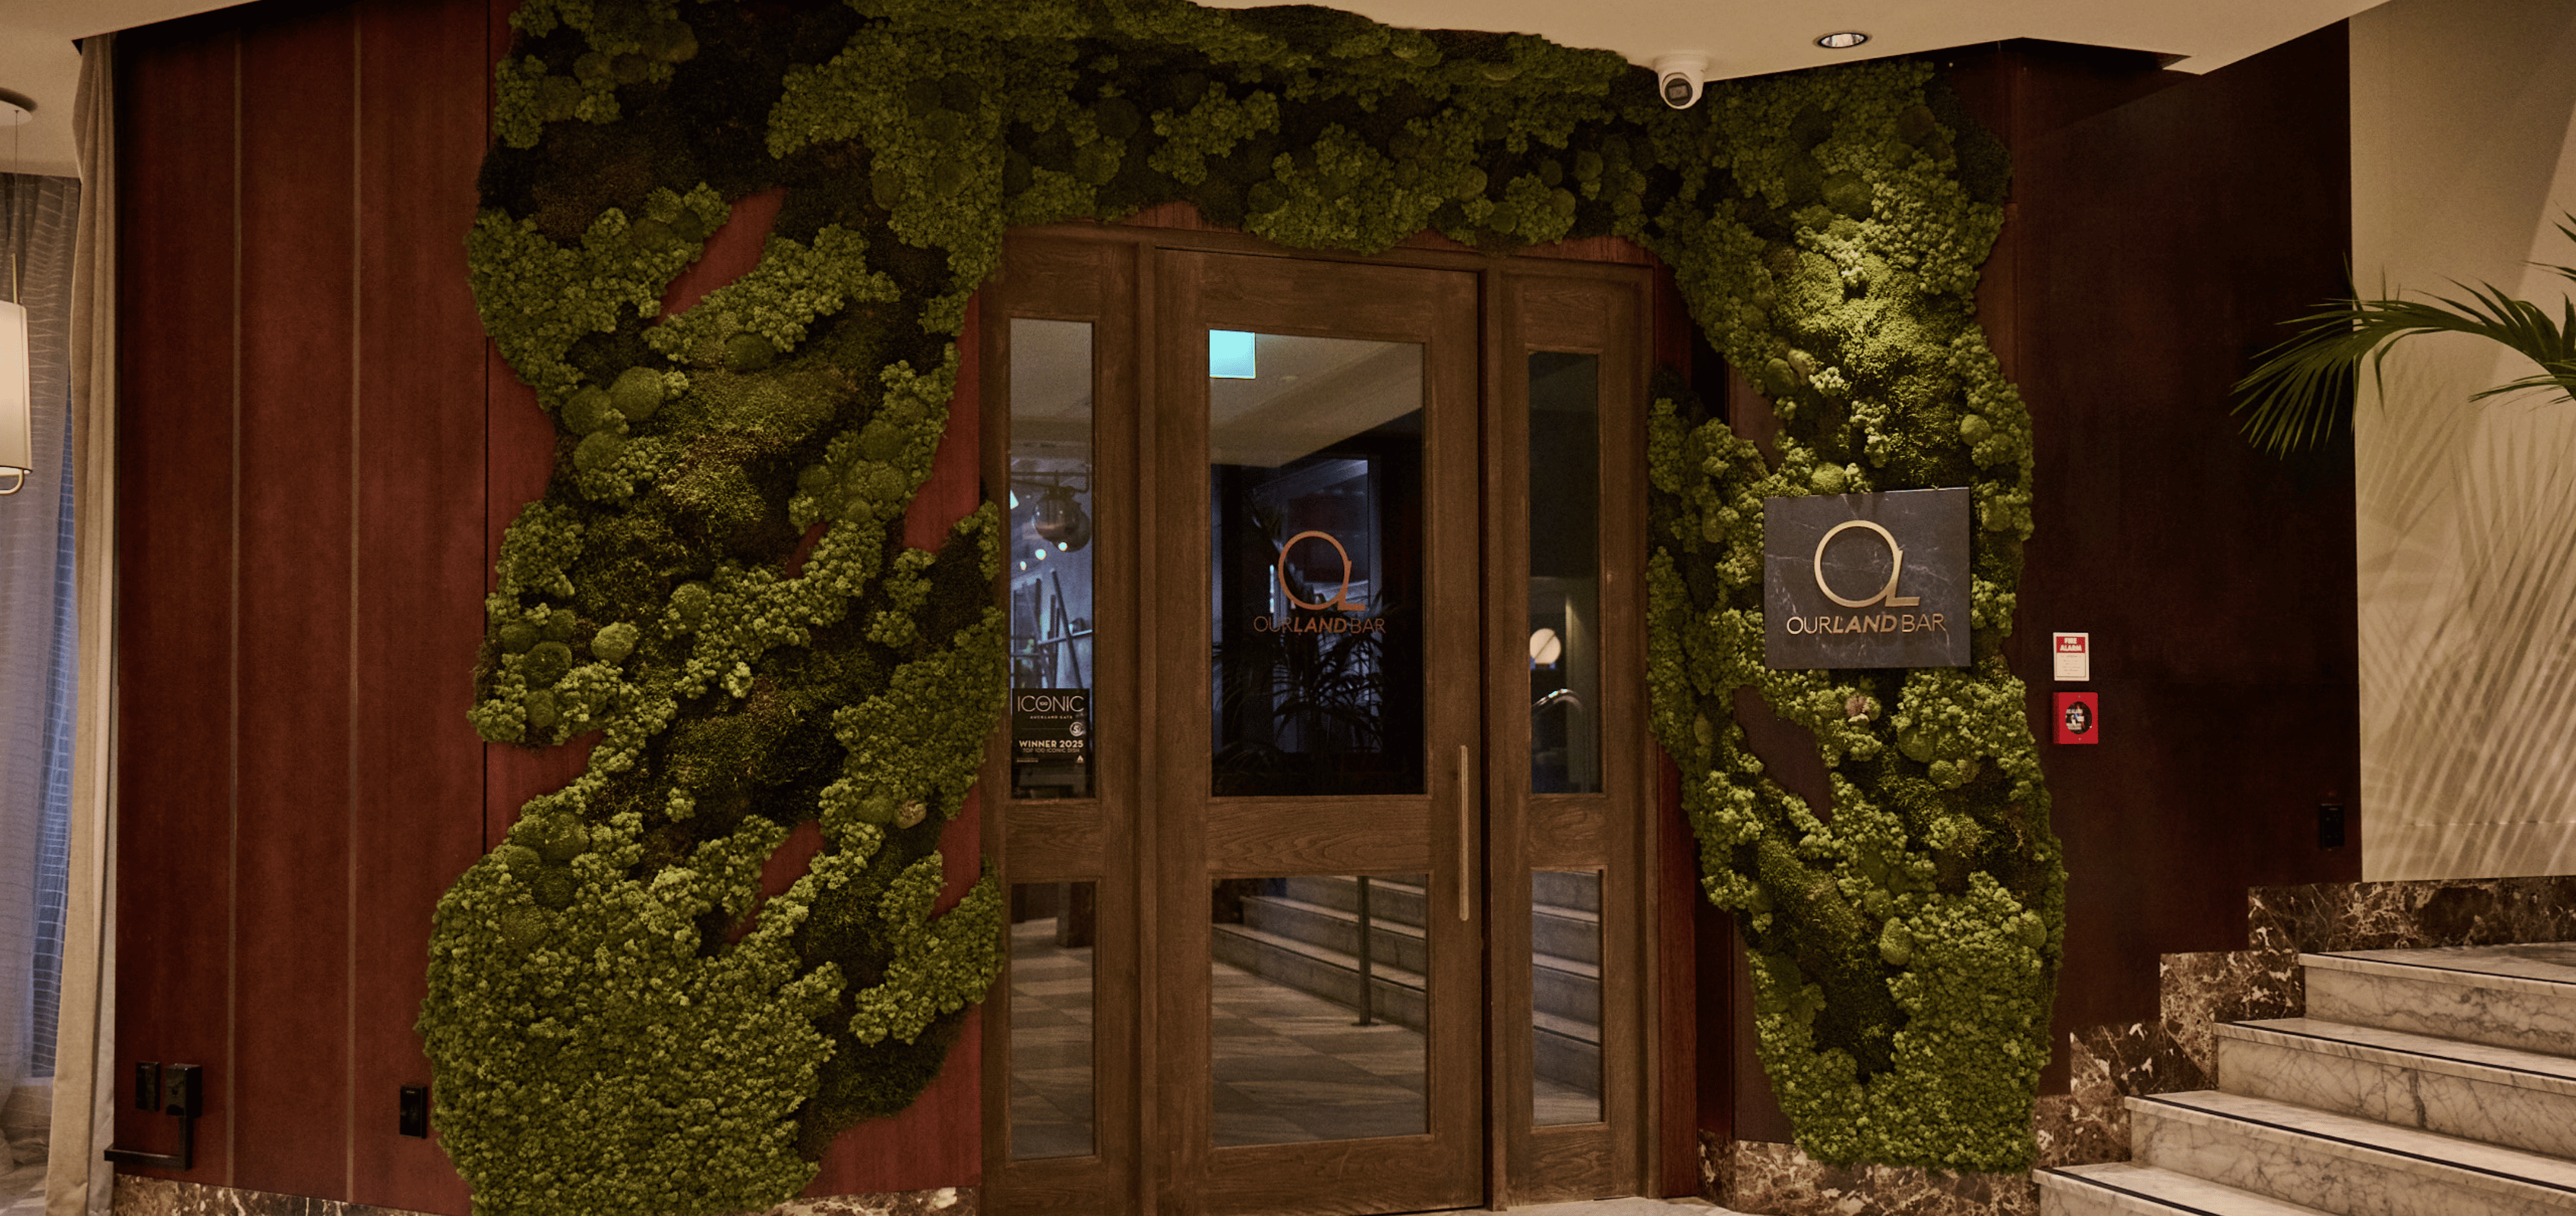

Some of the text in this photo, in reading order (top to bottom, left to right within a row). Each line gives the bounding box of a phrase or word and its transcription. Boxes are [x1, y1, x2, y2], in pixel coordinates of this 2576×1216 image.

[1351, 618, 1386, 634] BAR
[1902, 613, 1946, 632] BAR
[1017, 696, 1085, 712] ICONIC
[1018, 740, 1084, 748] WINNER 2025
